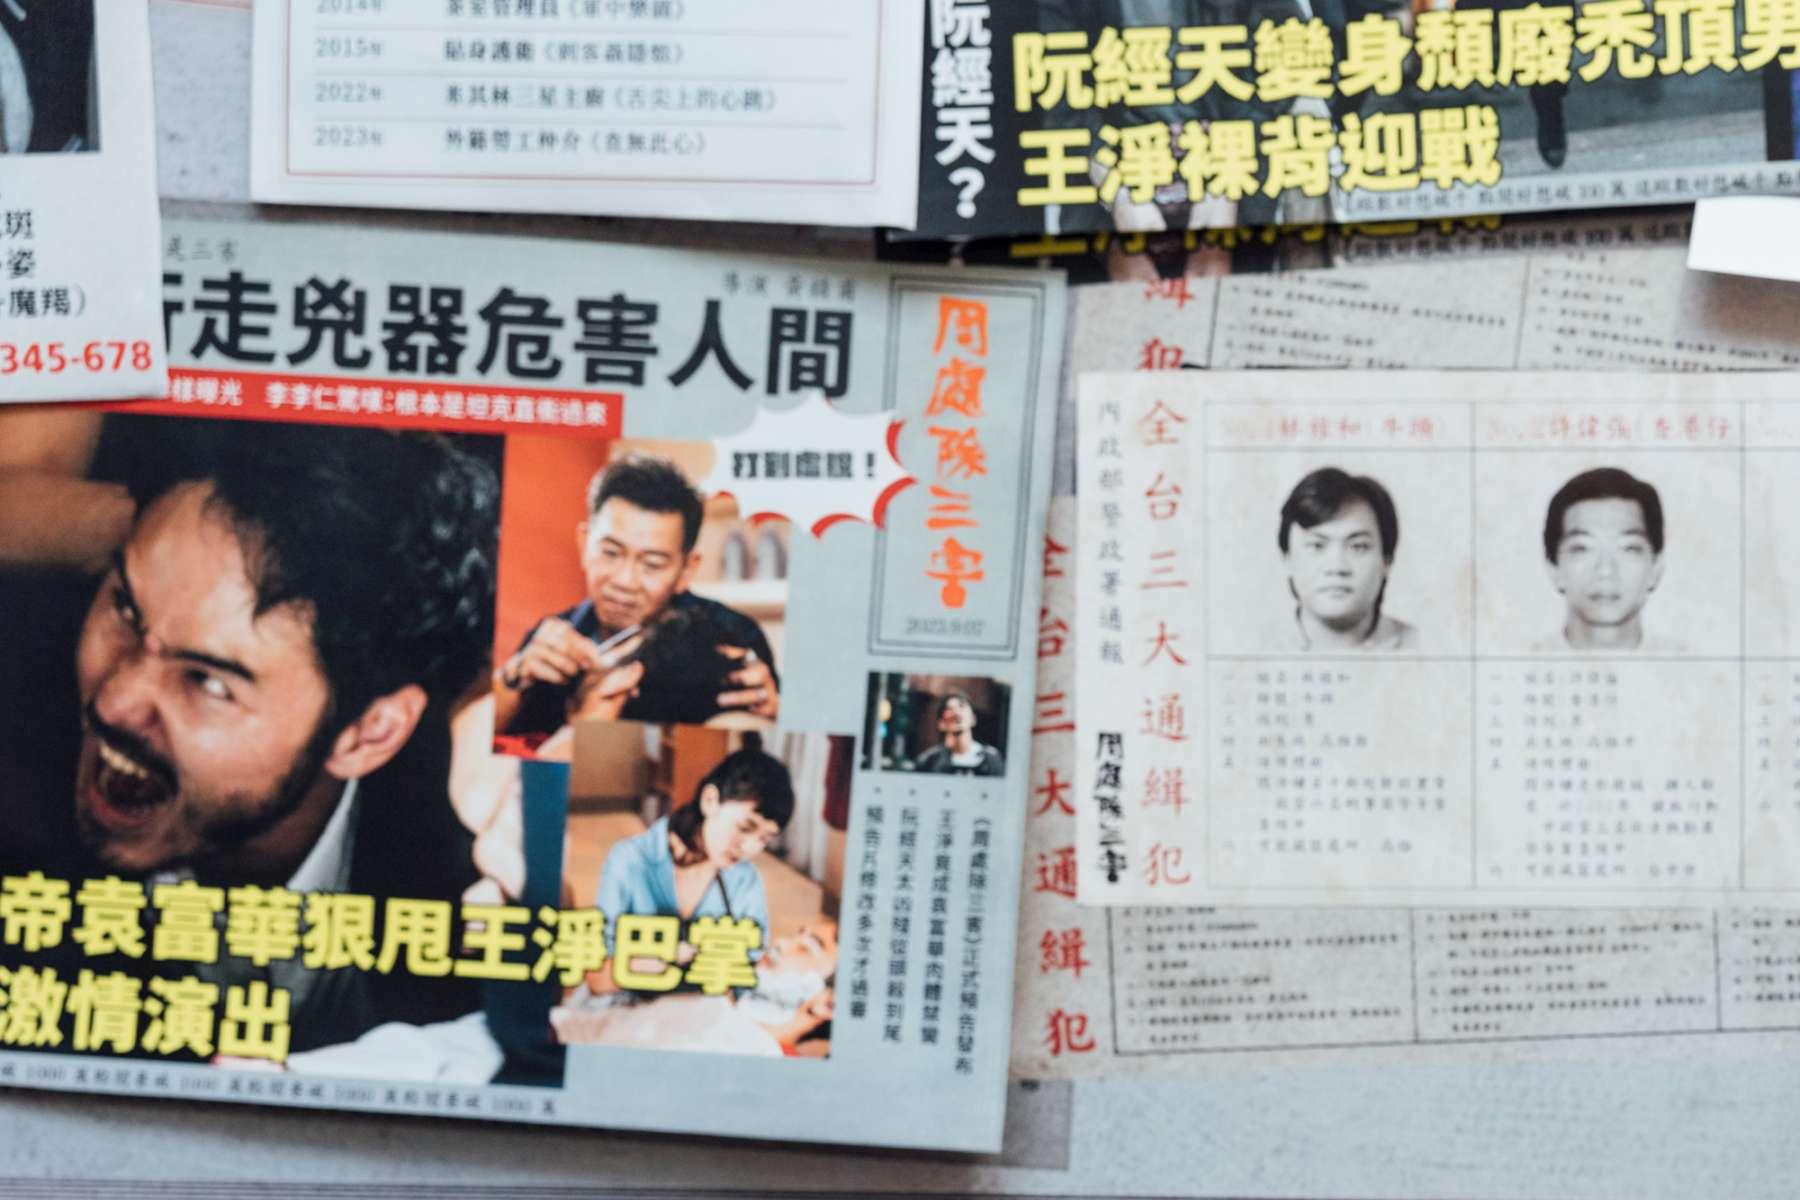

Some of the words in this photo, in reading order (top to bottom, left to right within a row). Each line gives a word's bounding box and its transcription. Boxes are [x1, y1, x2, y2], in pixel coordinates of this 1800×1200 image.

[1017, 105, 1503, 207] 王淨裸背迎戰
[1137, 399, 1191, 890] 全台三大通緝犯
